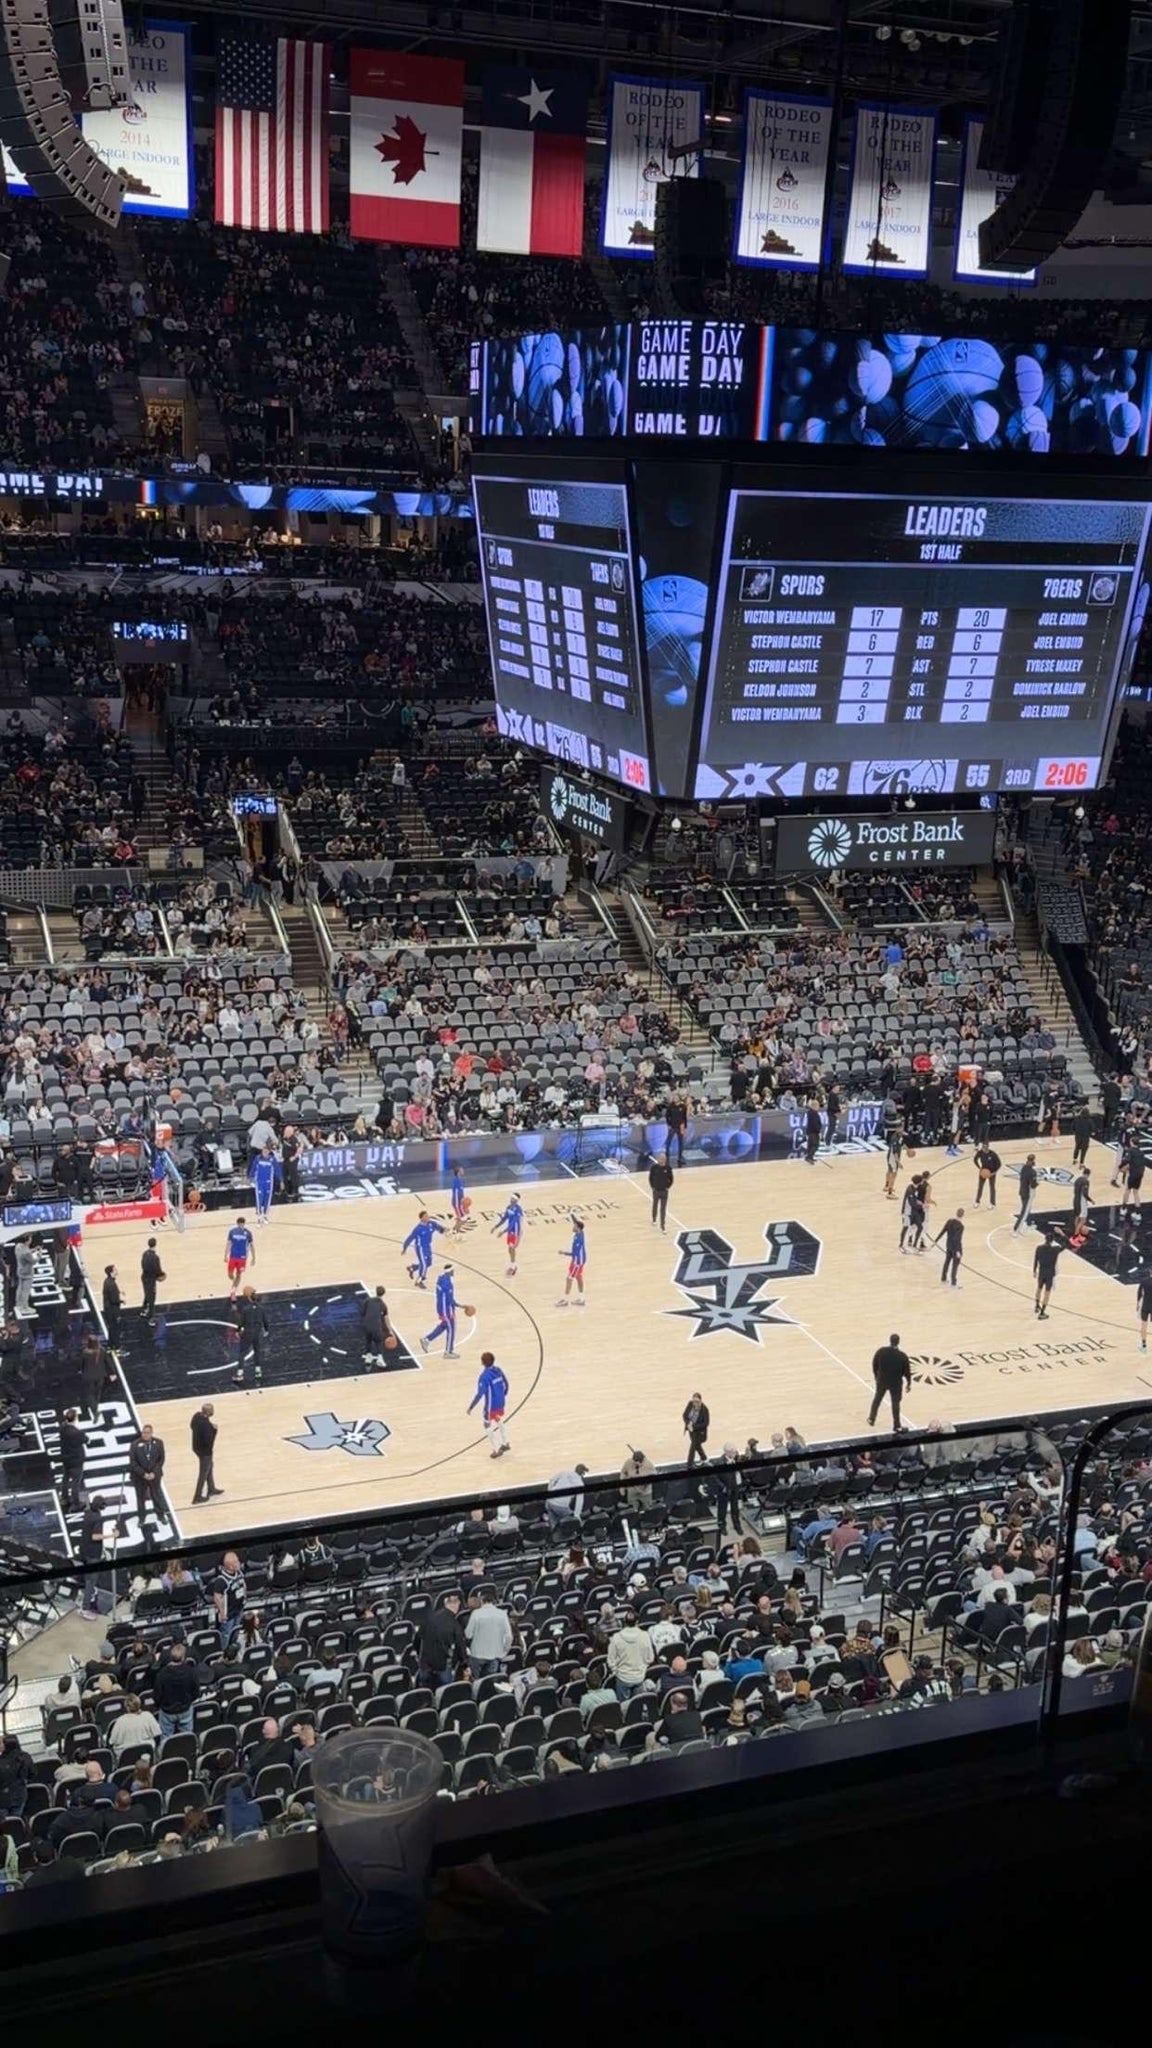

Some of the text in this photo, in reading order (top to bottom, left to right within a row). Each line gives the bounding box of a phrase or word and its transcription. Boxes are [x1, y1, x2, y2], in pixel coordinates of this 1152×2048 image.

[129, 56, 169, 73] THE
[629, 91, 685, 109] RODEO
[626, 112, 686, 130] OF THE
[764, 106, 821, 124] RODEO
[870, 116, 922, 133] RDEO
[120, 130, 151, 146] 2014
[761, 127, 822, 144] OF THE
[891, 140, 922, 153] THE
[100, 148, 180, 166] ARGE INDOOR
[770, 148, 810, 163] YEAR
[987, 171, 1015, 184] YEA
[773, 197, 799, 211] 2016
[617, 207, 647, 218] LARGE
[748, 211, 820, 227] LARGE INDOOR
[641, 327, 742, 356] GAME DAY
[637, 355, 743, 384] GAME DAY
[635, 412, 687, 435] GAME
[904, 505, 987, 537] LEADERS
[920, 544, 962, 560] 1ST HALF
[780, 575, 825, 596] SPURS
[1043, 578, 1083, 599] 76ERS
[744, 610, 836, 625] VICTOR WEMBANYAMA
[870, 610, 883, 627] 17
[921, 611, 938, 626] PTS
[973, 610, 990, 627] 20
[1038, 612, 1058, 626] JOEL
[751, 635, 823, 649] STEPHON CASTLE
[868, 634, 876, 650] 6
[973, 634, 981, 650] 6
[1034, 636, 1053, 649] JOEL
[748, 659, 819, 673] STEPHON CASTLE
[866, 659, 873, 674] 7
[912, 660, 931, 673] AST
[970, 658, 977, 674] 7
[1026, 659, 1083, 673] TYRESE MAXEY
[743, 683, 817, 698] KELDON JOHNSON
[861, 682, 869, 698] 2
[909, 683, 925, 697] STL
[965, 681, 973, 697] 2
[1013, 682, 1054, 696] DOMINICK
[731, 707, 821, 721] VICTOR WEMBANYAMA
[857, 706, 866, 722] 3
[904, 706, 924, 720] BLK
[960, 704, 969, 720] 2
[1020, 705, 1040, 719] JOEL
[814, 767, 840, 791] 62
[966, 764, 990, 787] 55
[1005, 769, 1031, 785] 3RD
[1045, 763, 1088, 786] 2:06
[568, 784, 612, 823] Frost Bank
[572, 813, 604, 838] CENTER
[856, 817, 964, 845] Frost Bank
[869, 849, 946, 862] CENTER
[848, 1107, 881, 1123] DAY
[366, 1145, 405, 1163] DAY
[480, 1199, 621, 1221] Frst Bank
[957, 1336, 1118, 1367] Frost Bank
[998, 1355, 1108, 1375] CENTER
